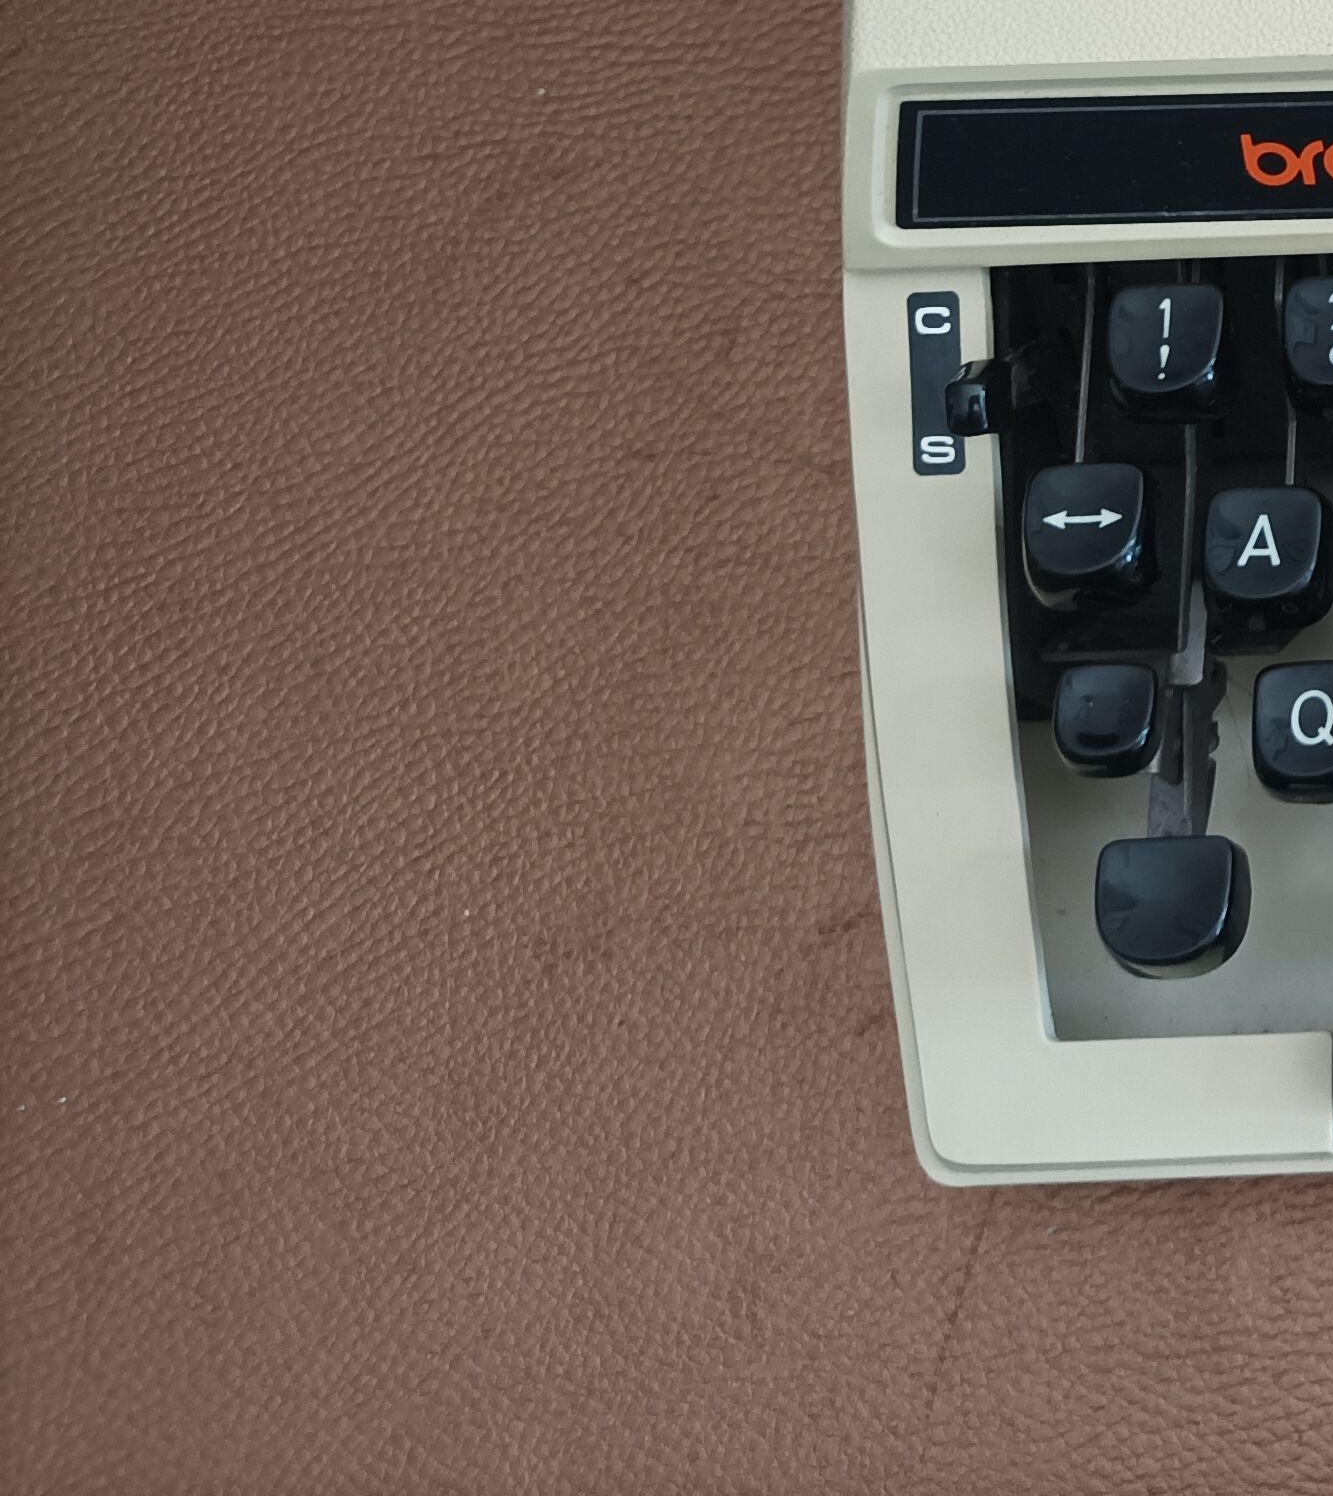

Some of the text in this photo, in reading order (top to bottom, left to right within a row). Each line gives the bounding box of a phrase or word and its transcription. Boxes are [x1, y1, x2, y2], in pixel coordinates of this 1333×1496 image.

[914, 306, 952, 336] C
[1159, 298, 1171, 339] 1
[1158, 344, 1170, 380] !
[920, 435, 956, 464] S
[1237, 514, 1281, 567] A
